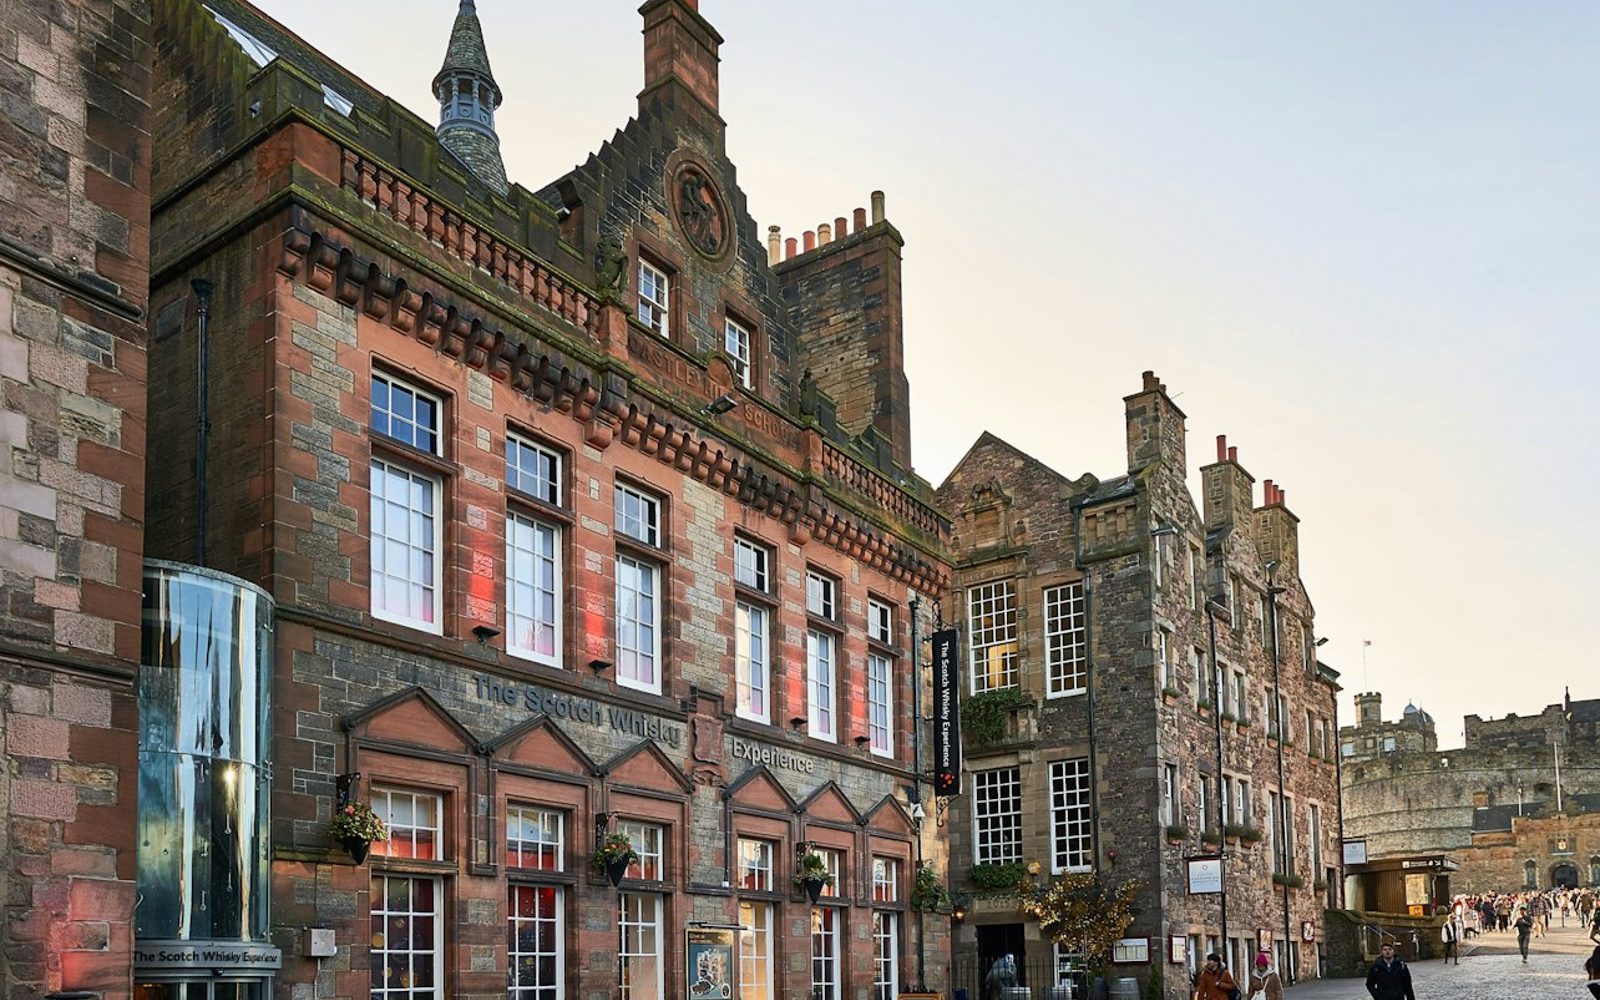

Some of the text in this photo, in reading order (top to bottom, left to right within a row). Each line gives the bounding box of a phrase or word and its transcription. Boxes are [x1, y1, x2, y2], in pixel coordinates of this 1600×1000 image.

[473, 674, 815, 773] The Scotch Whisky Experience
[941, 642, 951, 768] The Scotch Whisky Experience
[134, 951, 155, 962] The
[159, 951, 199, 962] Scotch
[203, 951, 241, 964] Whisky
